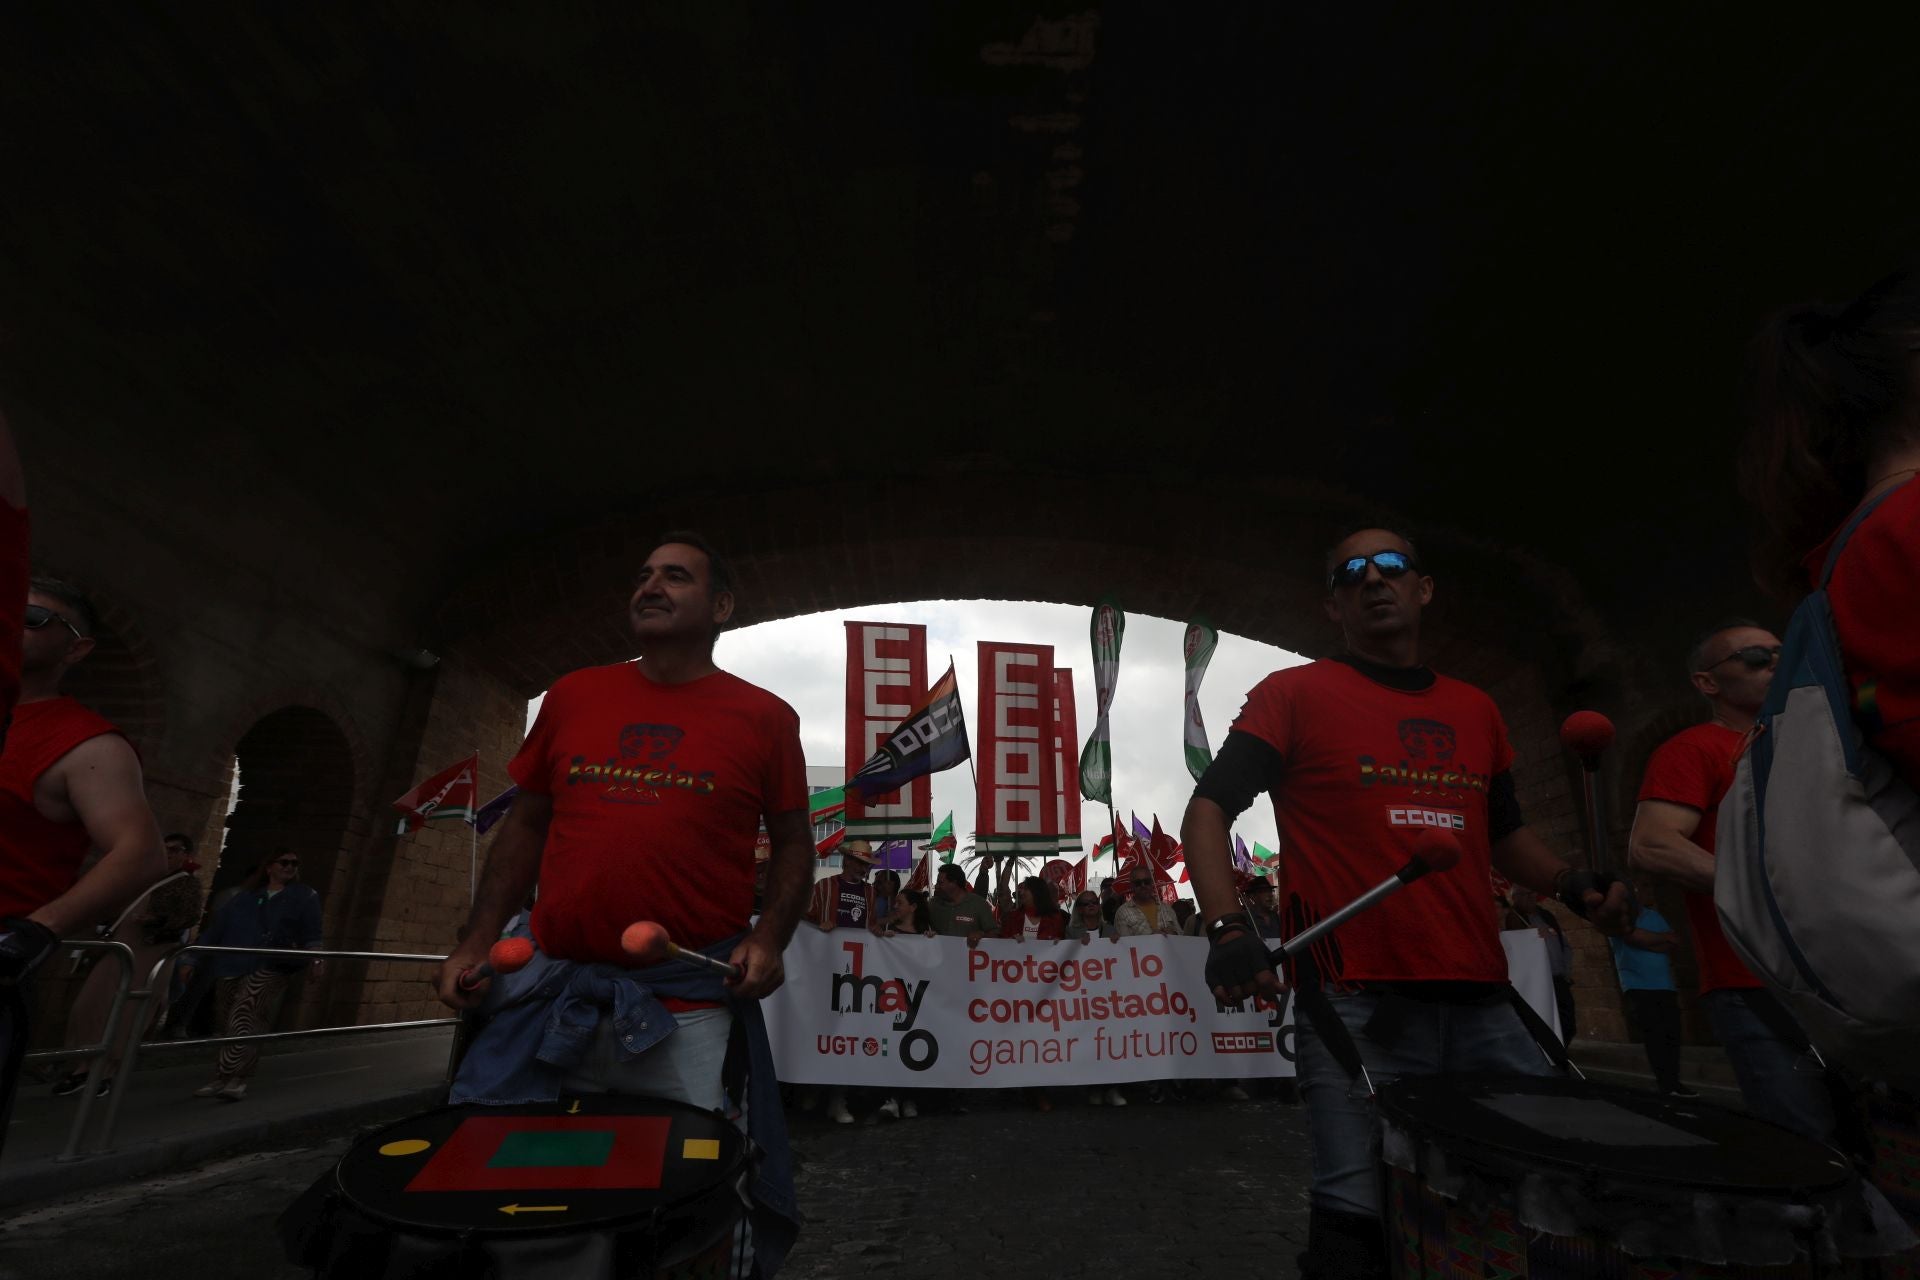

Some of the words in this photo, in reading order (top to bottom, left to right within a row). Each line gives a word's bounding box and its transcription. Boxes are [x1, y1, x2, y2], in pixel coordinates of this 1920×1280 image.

[994, 650, 1041, 834] CCOO
[1390, 809, 1450, 828] CCOO
[968, 949, 1118, 991] Proteger
[1130, 947, 1163, 978] lo
[967, 983, 1197, 1031] conquistado,
[817, 1035, 859, 1056] UGT
[970, 1036, 1077, 1075] ganar
[1095, 1026, 1198, 1062] futuro
[1214, 1036, 1256, 1050] CCOO
